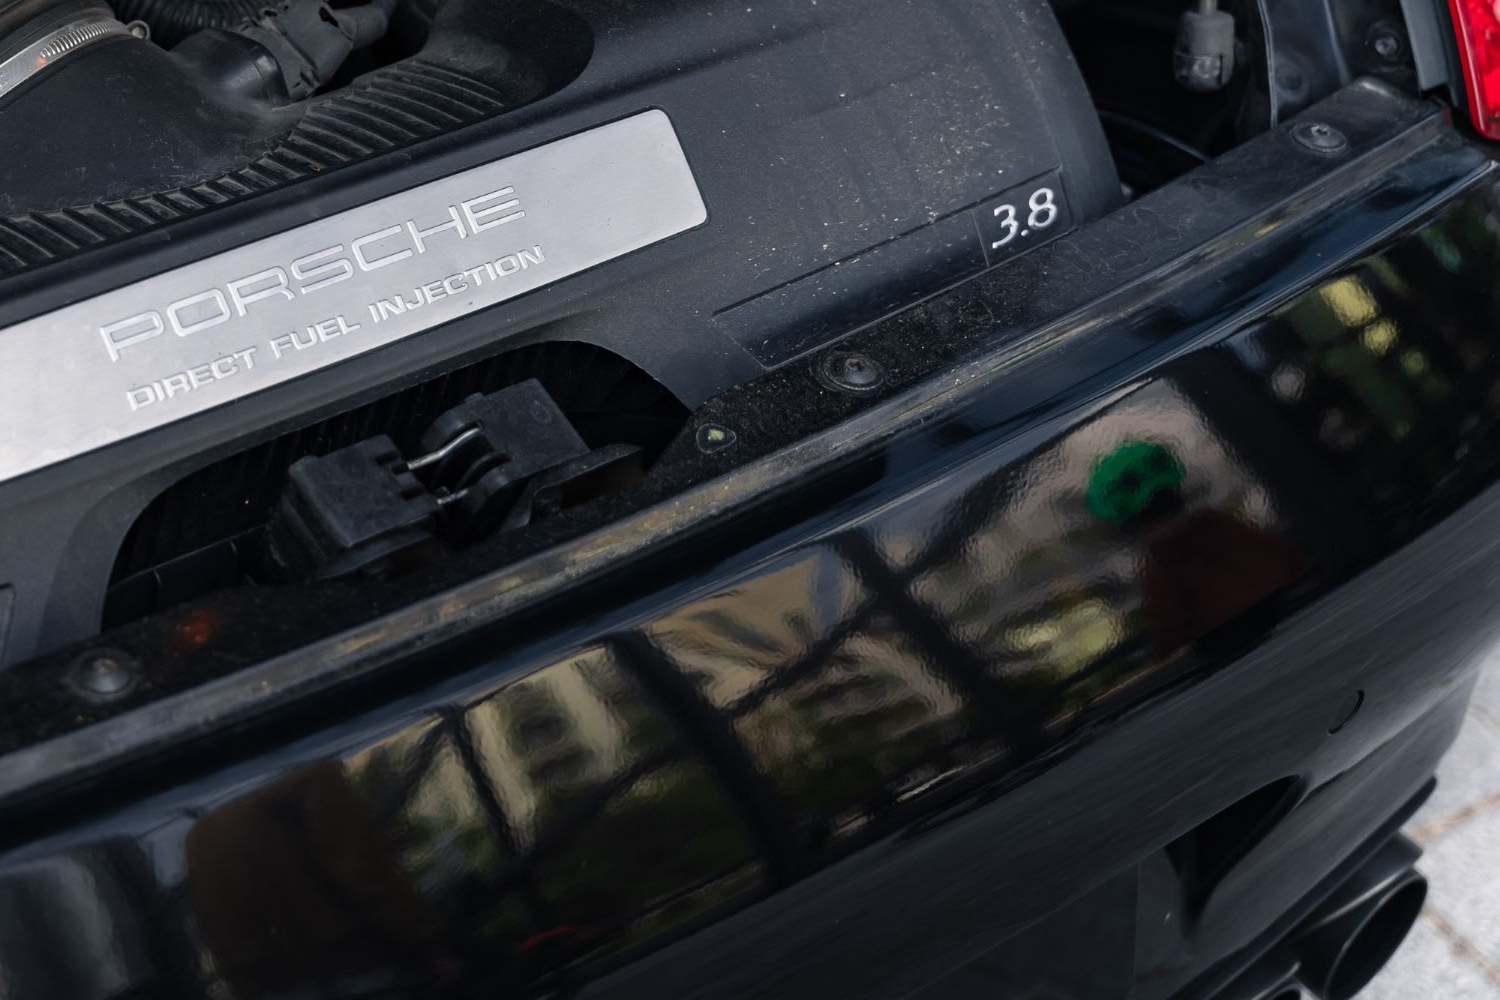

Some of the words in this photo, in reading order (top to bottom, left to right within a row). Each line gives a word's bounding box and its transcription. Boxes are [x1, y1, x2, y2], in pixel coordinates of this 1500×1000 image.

[100, 185, 526, 362] PORSCHE
[991, 187, 1058, 249] 3.8
[126, 346, 257, 411] DIRECT
[270, 314, 361, 359] FUEL
[368, 244, 546, 324] INJECTION
